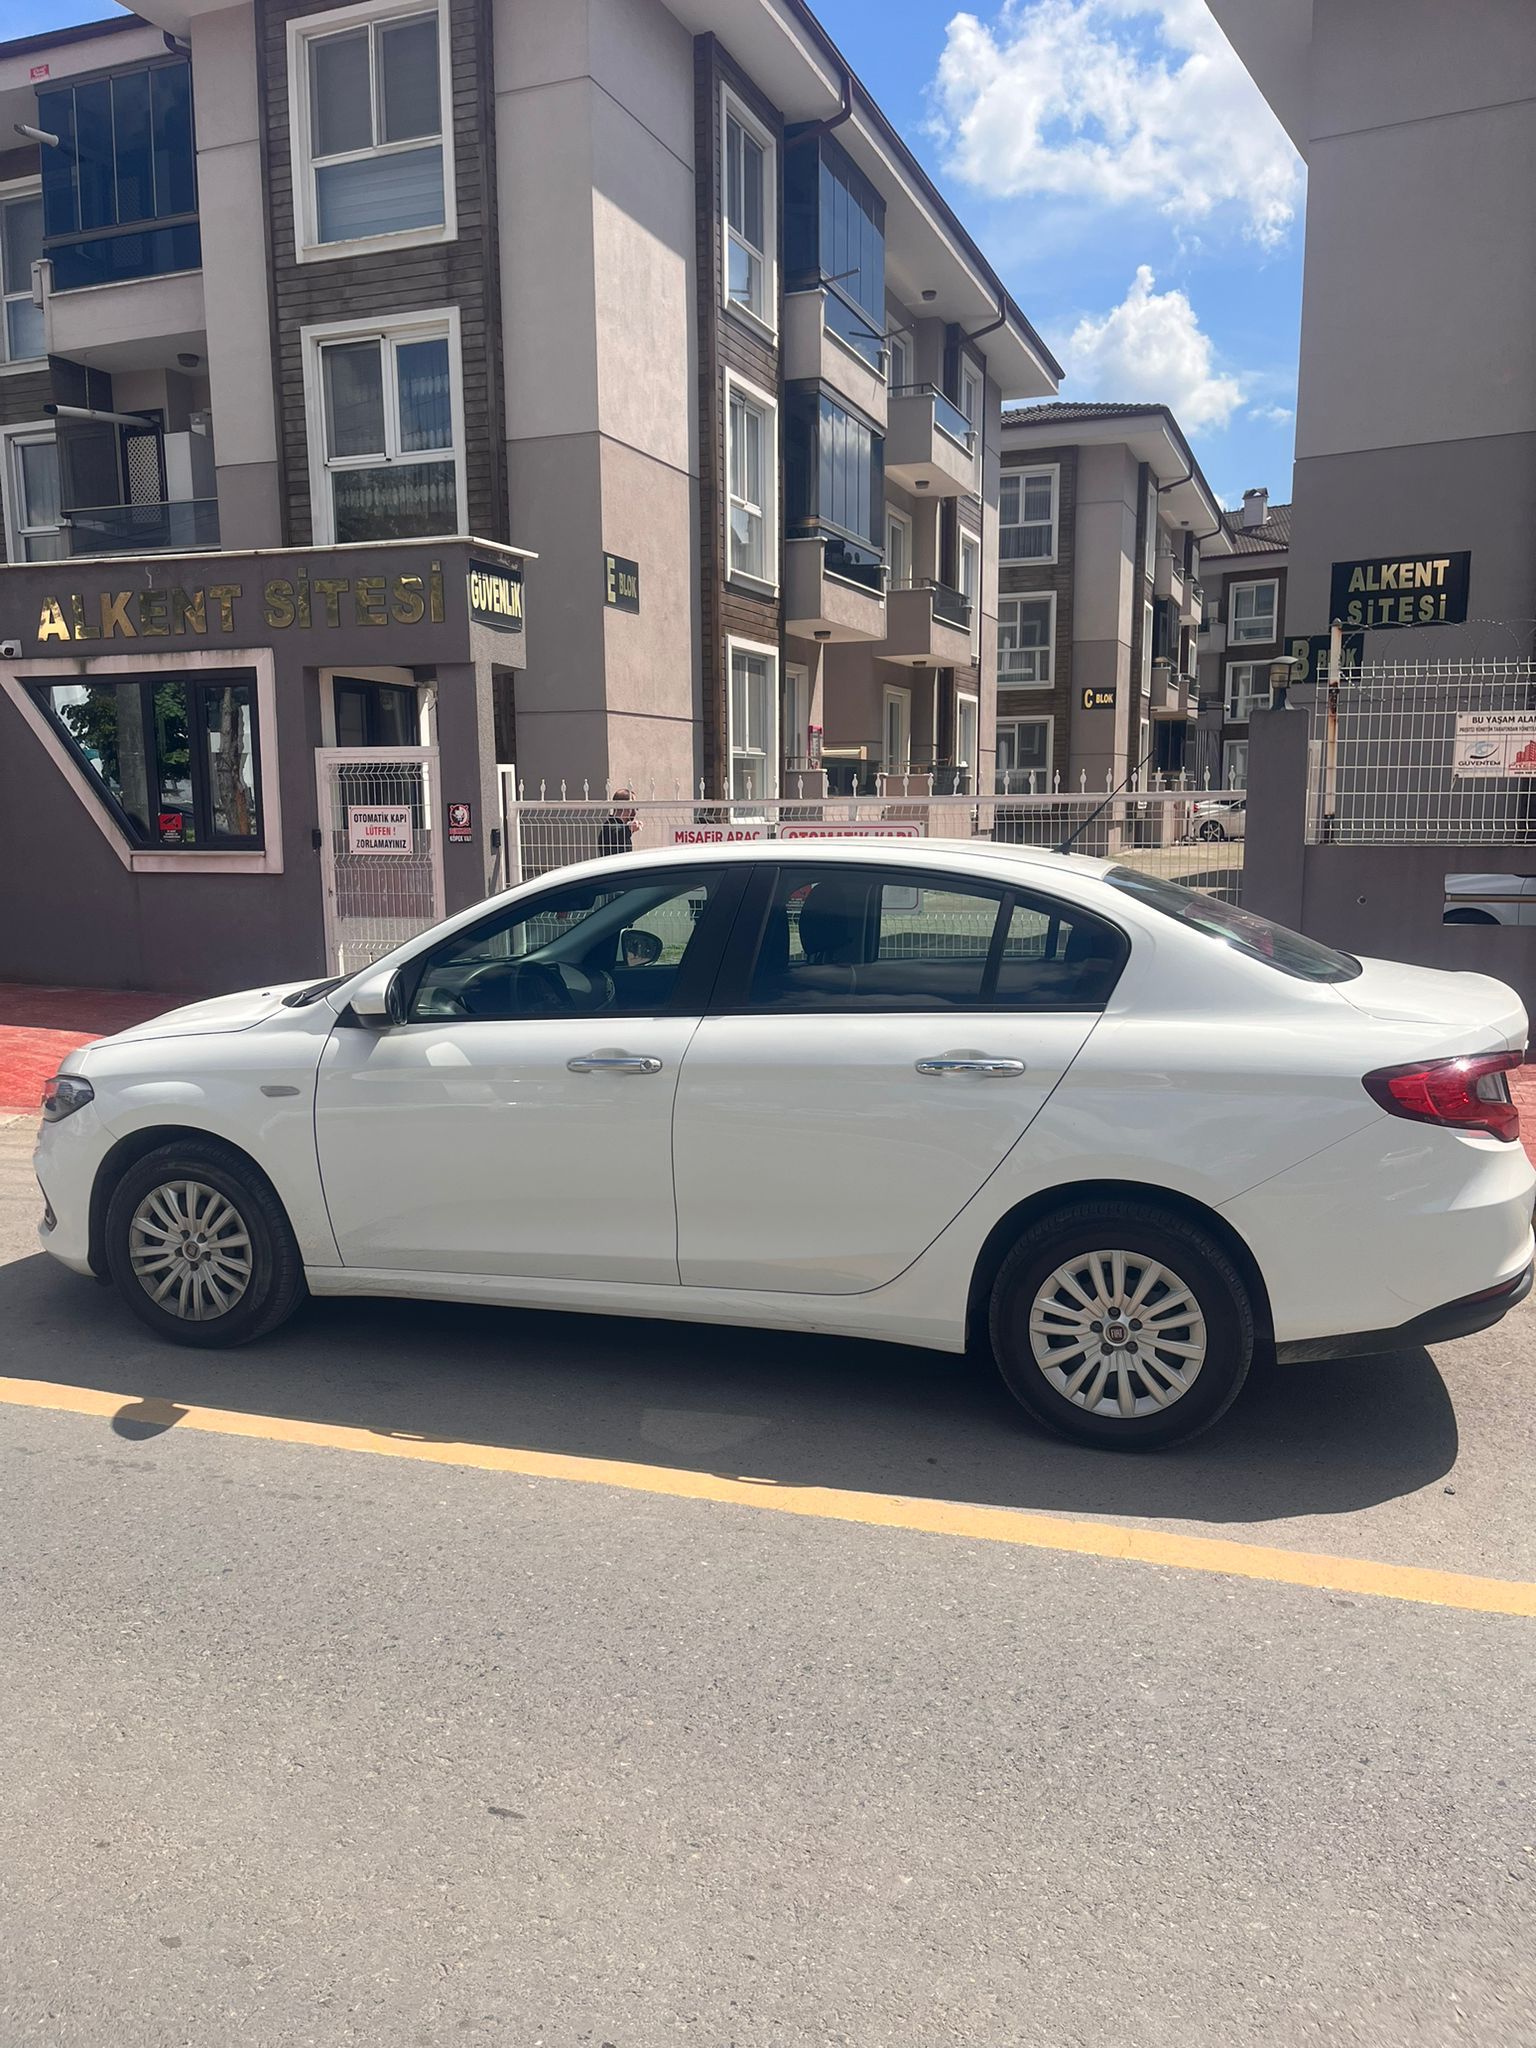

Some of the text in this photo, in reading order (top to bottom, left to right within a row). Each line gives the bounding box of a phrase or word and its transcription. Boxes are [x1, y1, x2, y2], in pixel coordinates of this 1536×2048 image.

[606, 556, 637, 603] E BLOK
[1348, 559, 1450, 593] ALKENT
[38, 560, 445, 642] ALKENT SİTESİ
[470, 569, 522, 618] GÜVENLİK
[1346, 593, 1447, 624] SİTESİ
[1290, 639, 1310, 684] B
[1084, 688, 1114, 708] C BLOK
[1472, 716, 1484, 724] BU
[1486, 715, 1516, 725] YAŞAM
[353, 811, 407, 824] OTOMATİK KAPI
[365, 825, 391, 836] LÜTFEN
[674, 830, 723, 844] MİSAFİR
[356, 839, 407, 849] ZORLAMAYINIZ
